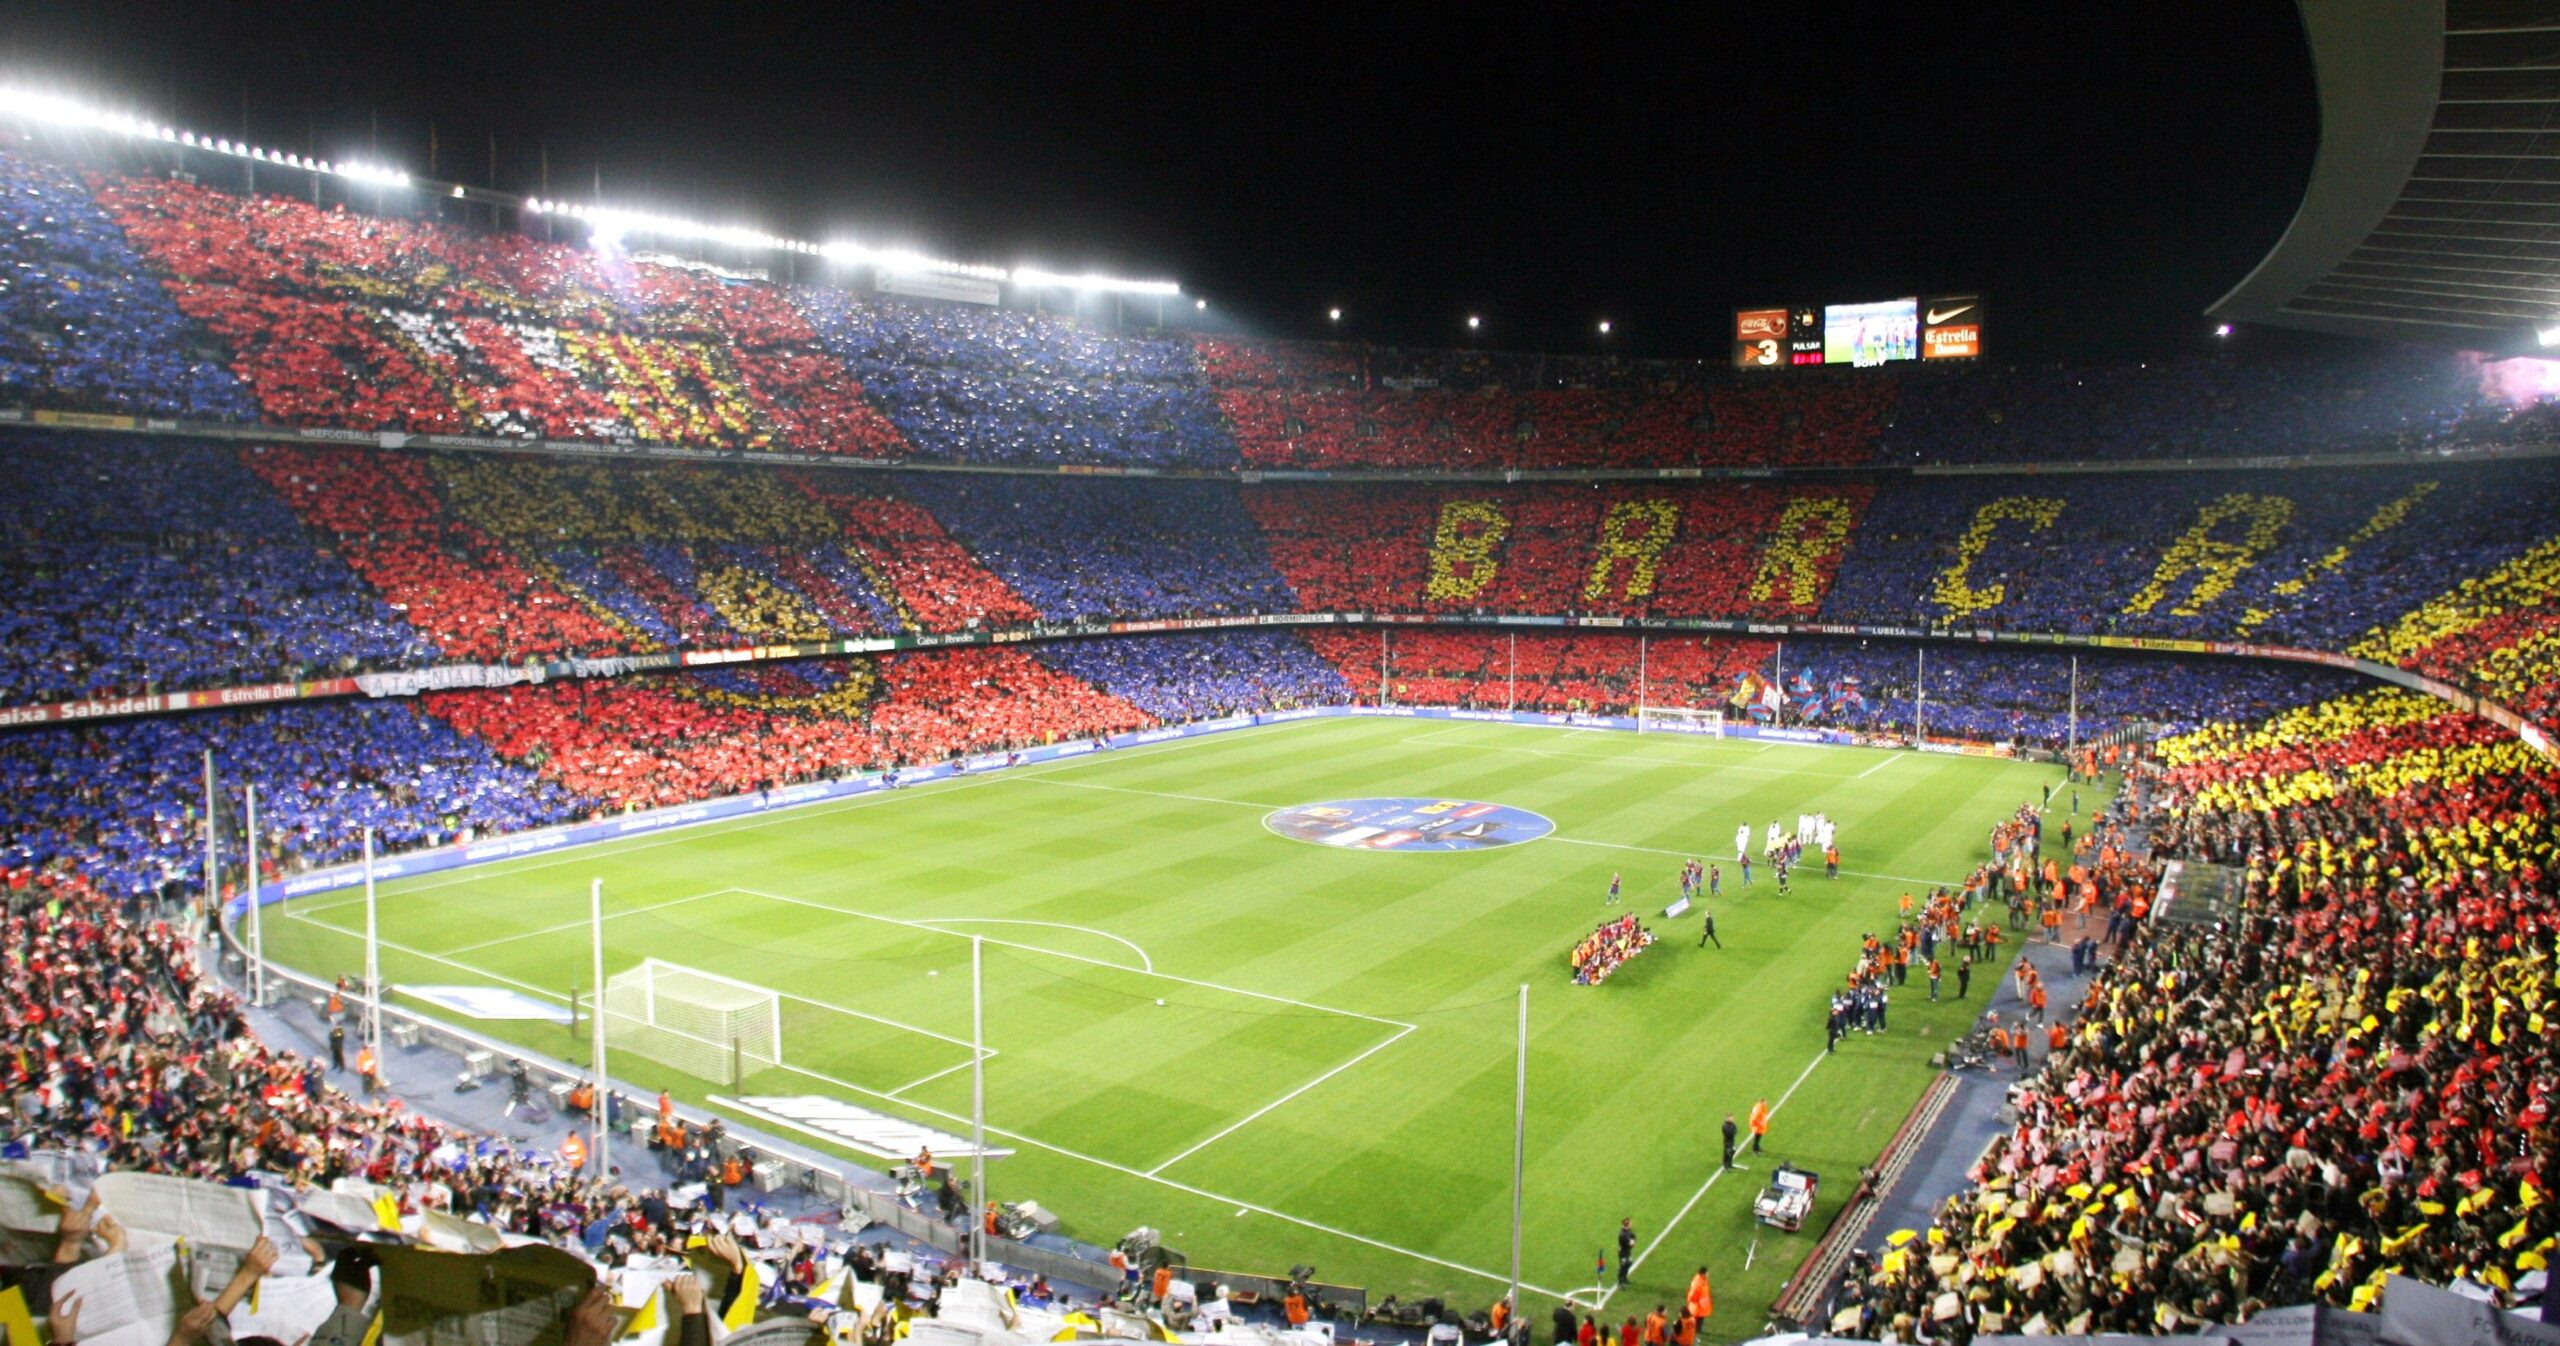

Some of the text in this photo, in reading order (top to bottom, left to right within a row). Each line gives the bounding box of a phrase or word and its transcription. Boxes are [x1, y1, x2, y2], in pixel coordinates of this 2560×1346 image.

[1925, 329, 1977, 343] Estrella
[1758, 339, 1778, 365] 3
[1220, 617, 1255, 626] Sabadell
[1872, 628, 1905, 636] LUBESA
[221, 687, 269, 704] Estrella
[60, 696, 161, 719] Sabadell
[2254, 1314, 2310, 1327] ARCELON
[2472, 1316, 2493, 1334] FC
